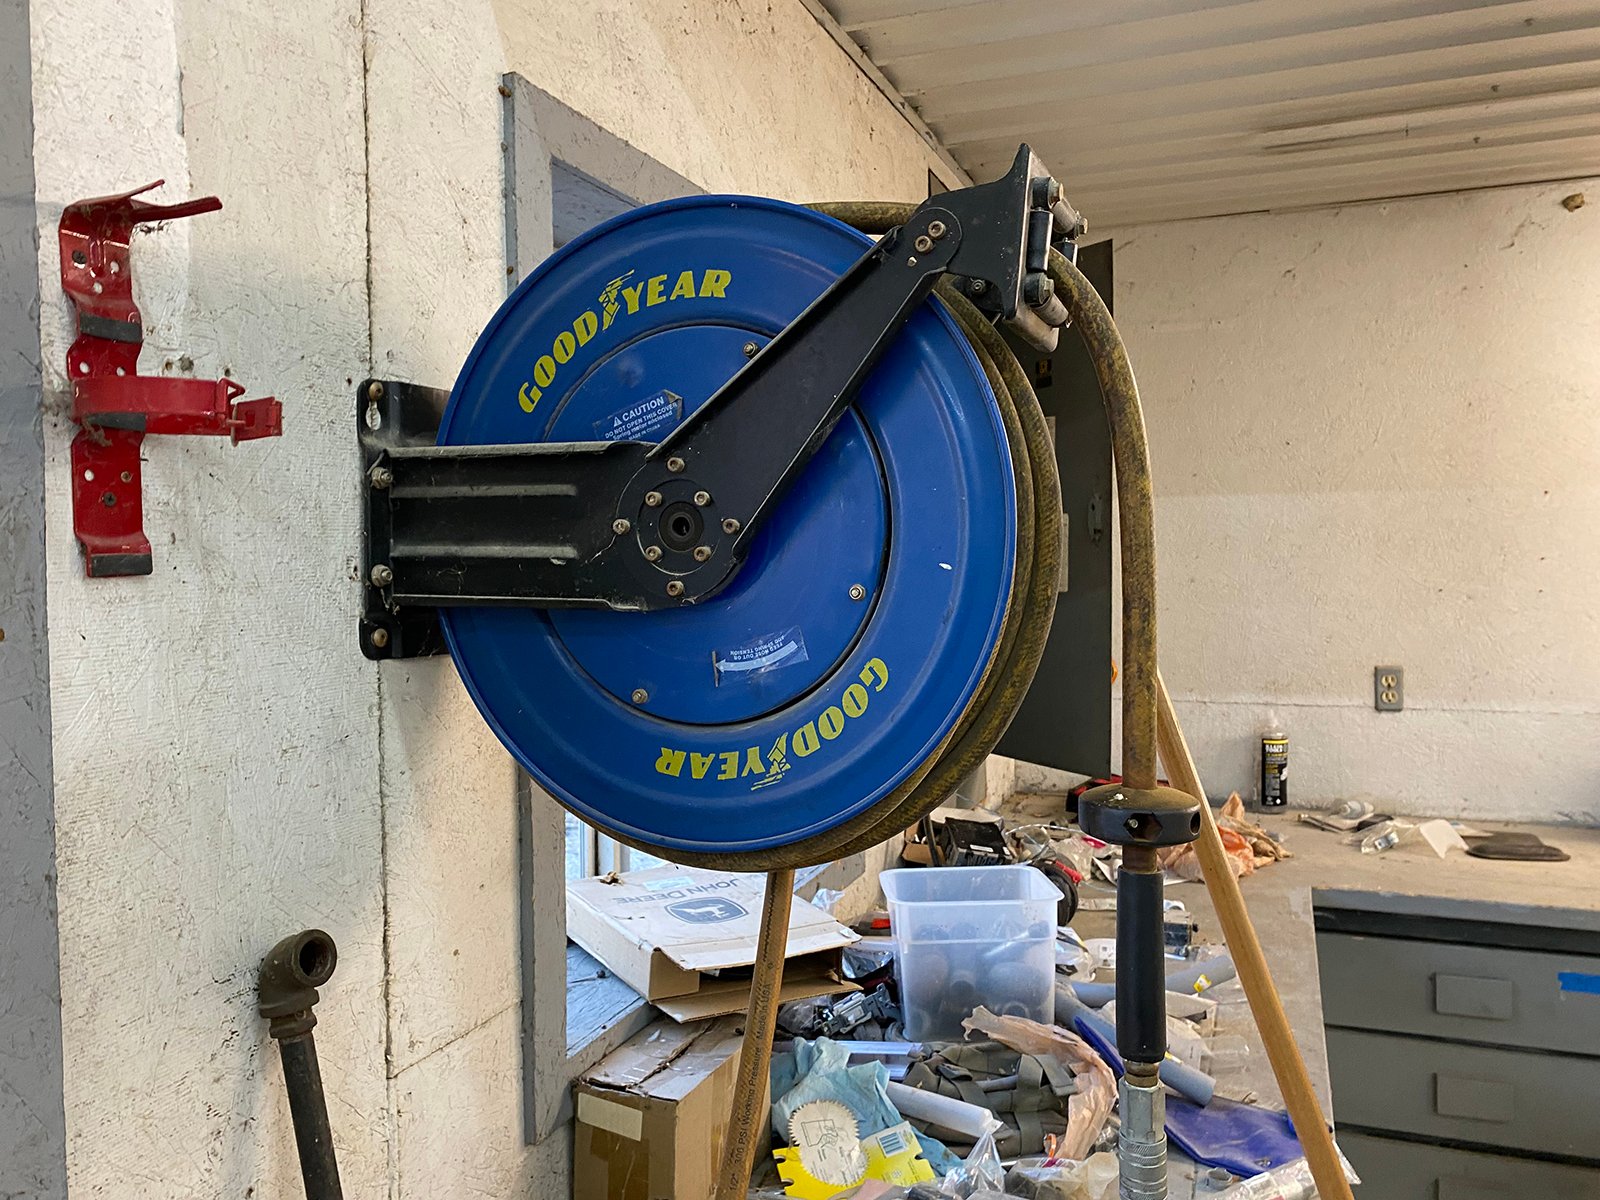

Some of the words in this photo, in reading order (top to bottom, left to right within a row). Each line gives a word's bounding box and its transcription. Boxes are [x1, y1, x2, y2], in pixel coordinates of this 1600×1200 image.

[518, 268, 733, 414] GOODYEAR
[622, 396, 665, 421] CAUTION
[612, 429, 632, 441] Spring
[631, 423, 648, 433] motor
[647, 411, 673, 425] enclosed
[613, 425, 626, 435] NOT
[626, 418, 643, 429] OPEN
[642, 412, 657, 422] THIS
[657, 402, 679, 415] COVER
[628, 432, 641, 440] MADE
[646, 424, 661, 433] CHINA
[754, 642, 773, 652] SPRING
[769, 642, 783, 652] FEED
[774, 635, 785, 644] ADD
[729, 648, 754, 656] TENSION
[754, 648, 770, 658] HOSE
[655, 657, 889, 790] GOODYEAR
[686, 878, 739, 895] JOHN
[612, 890, 687, 904] DEERE
[761, 984, 771, 1004] USA
[756, 1014, 767, 1040] Made
[748, 1047, 761, 1087] Pressure
[742, 1089, 756, 1125] Working
[738, 1127, 748, 1144] PSI
[735, 1148, 745, 1165] 300
